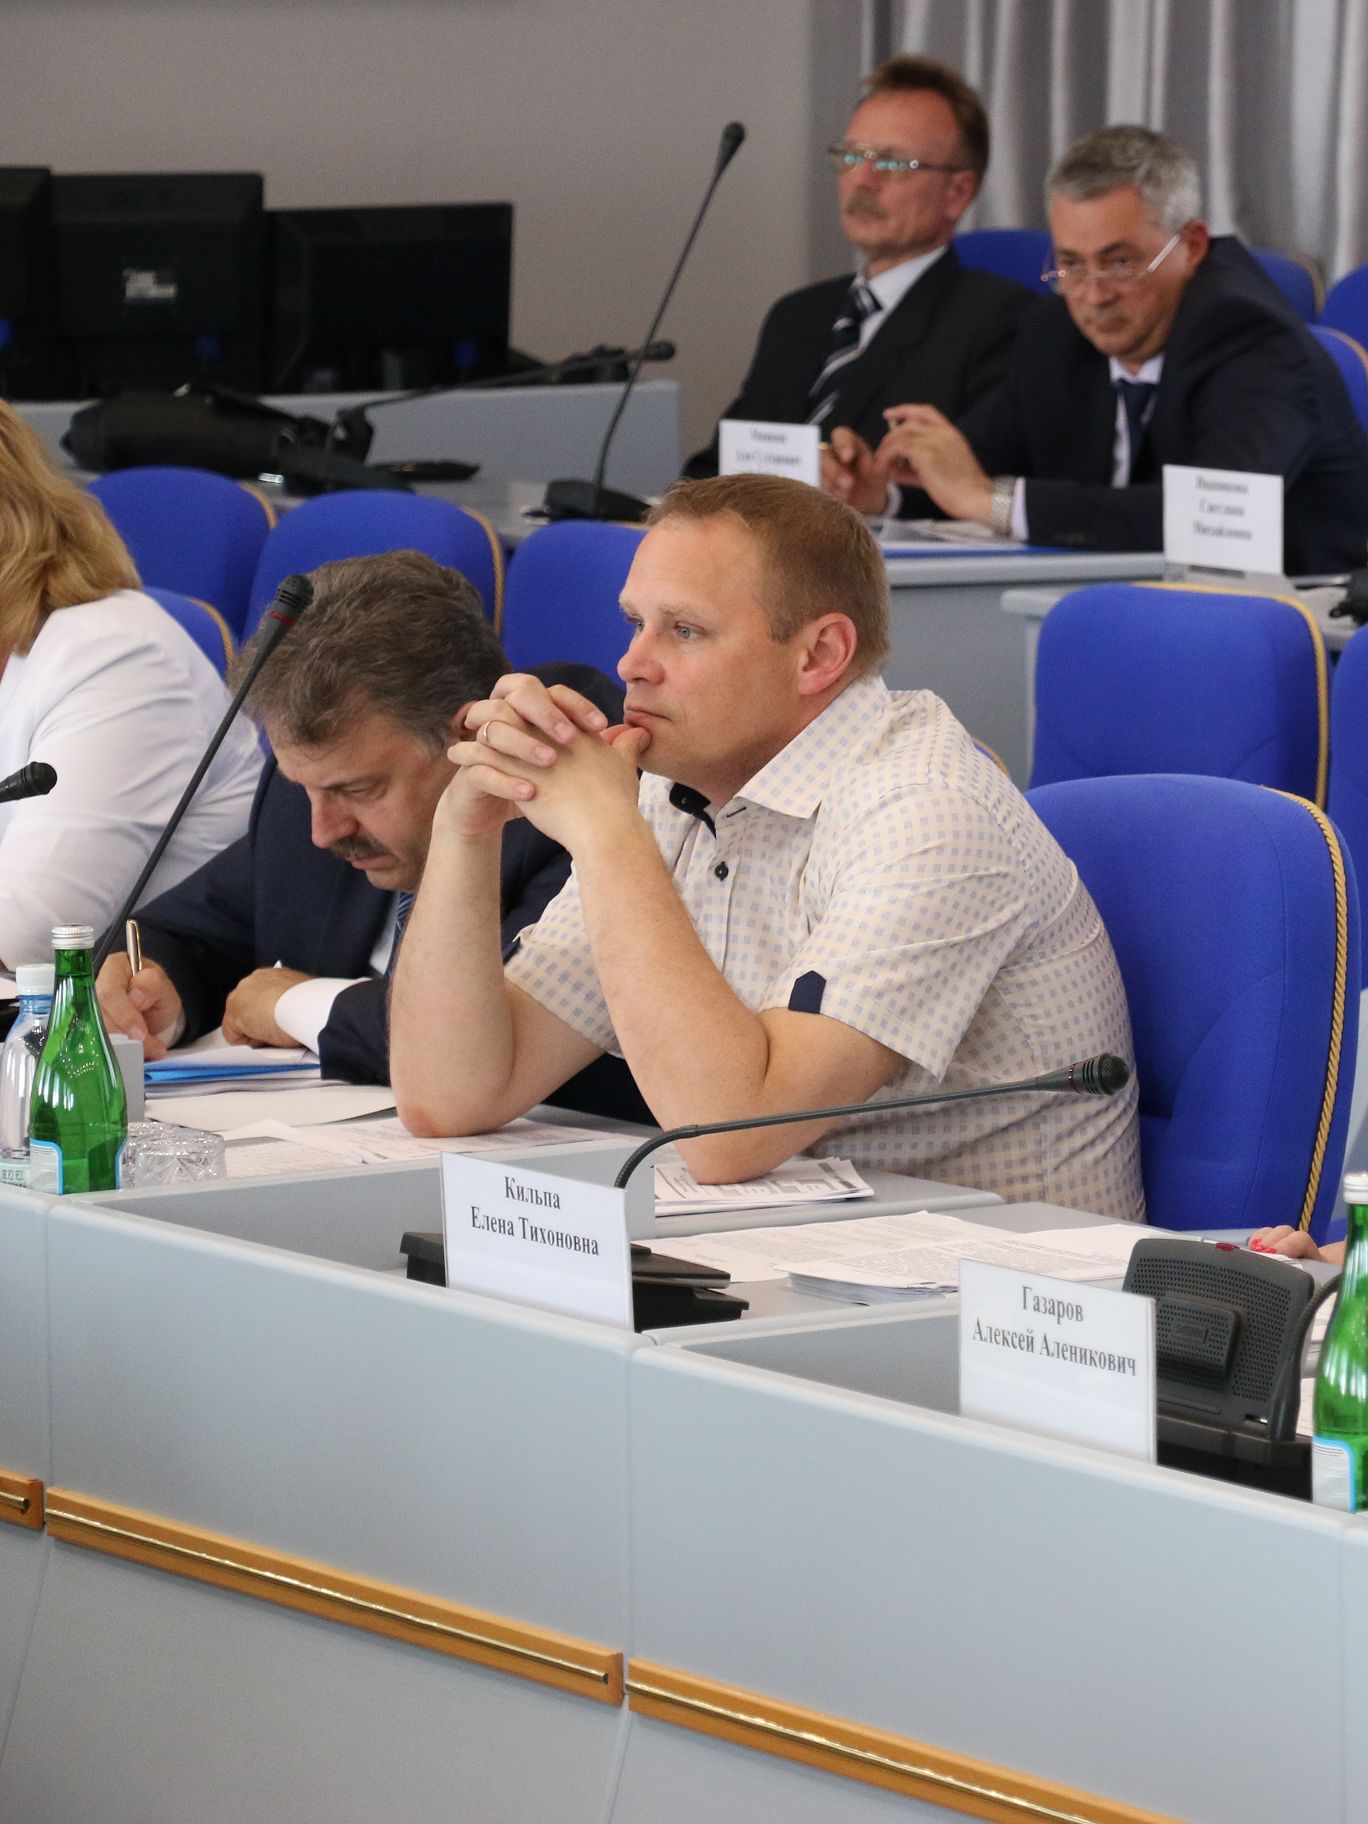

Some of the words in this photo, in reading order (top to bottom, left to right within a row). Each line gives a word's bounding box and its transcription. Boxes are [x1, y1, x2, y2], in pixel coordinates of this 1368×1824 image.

[504, 1175, 561, 1210] Кильпа
[471, 1205, 515, 1237] Елена
[518, 1215, 600, 1256] Тихоновна
[1021, 1285, 1085, 1326] Газаров
[972, 1315, 1036, 1354] Алексей
[1039, 1332, 1137, 1378] Аленикович
